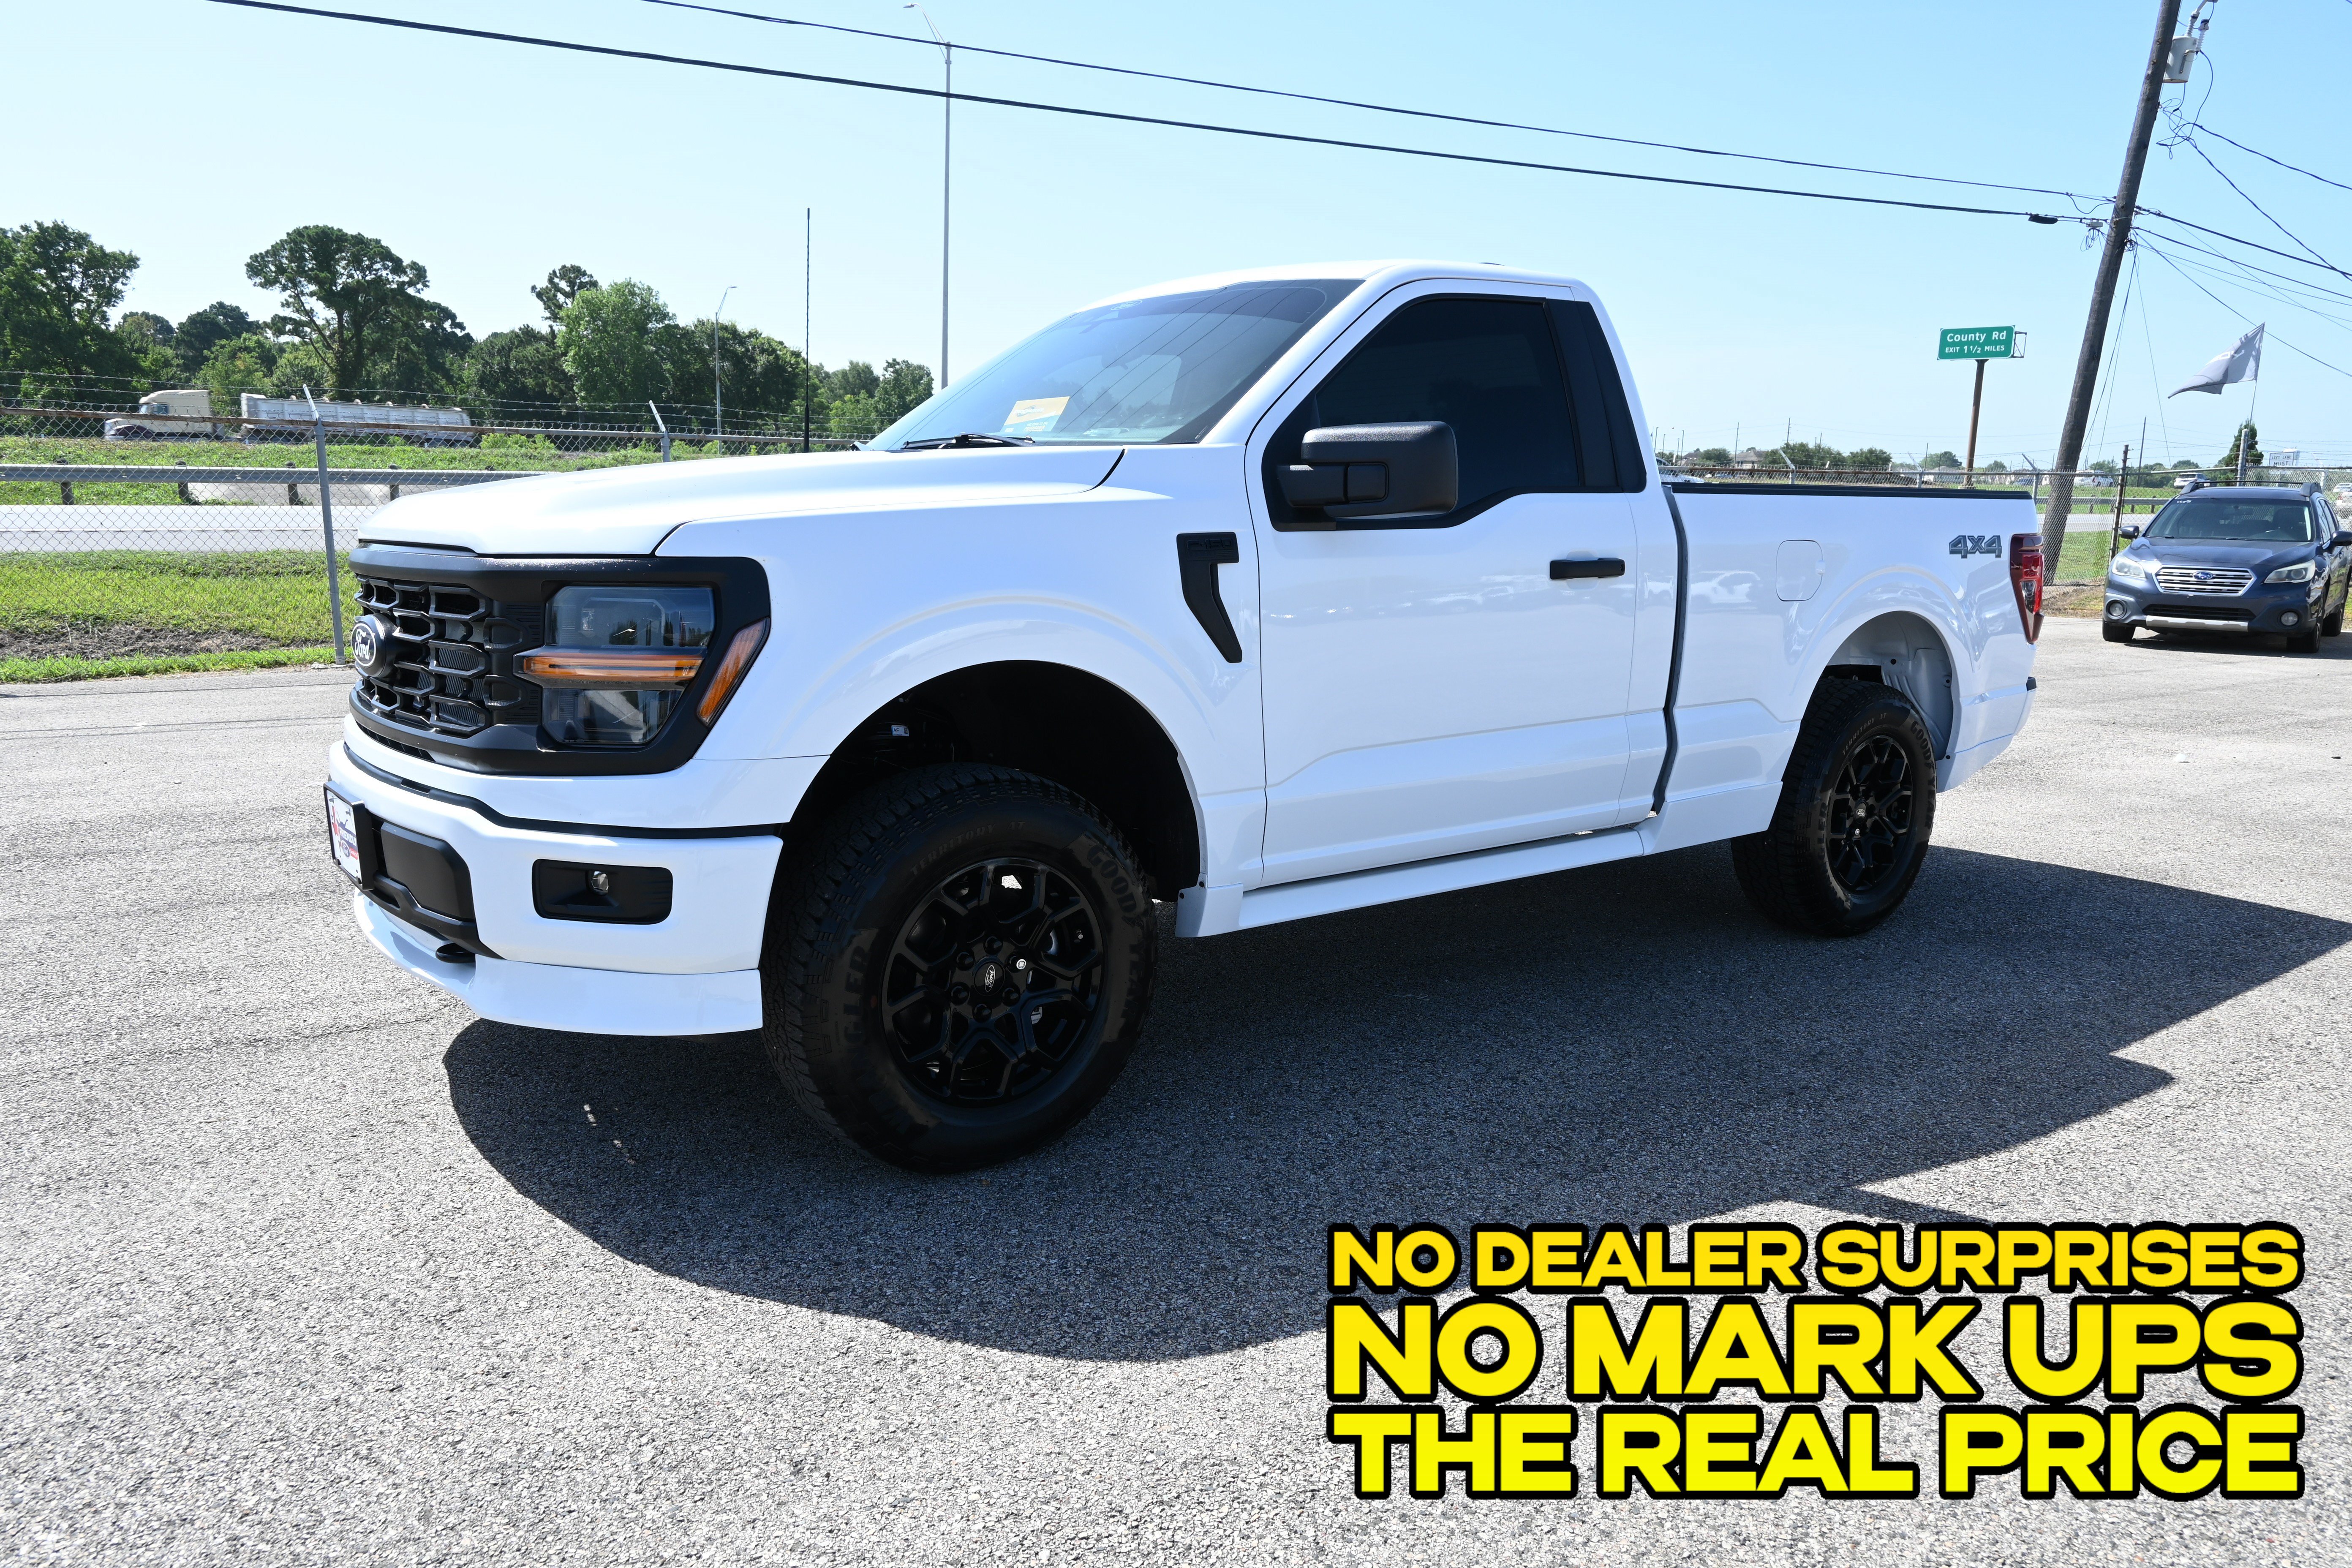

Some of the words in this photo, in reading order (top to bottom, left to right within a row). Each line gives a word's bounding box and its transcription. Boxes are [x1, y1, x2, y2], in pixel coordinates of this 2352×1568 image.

[1947, 333, 1986, 343] County
[1992, 330, 2006, 340] Rd
[1186, 538, 1233, 550] F-150
[355, 629, 370, 660] Ford
[1842, 717, 1876, 756] TERRITORY
[910, 824, 995, 876] TERRITORY
[1007, 820, 1026, 831] AT
[985, 969, 994, 988] Ford
